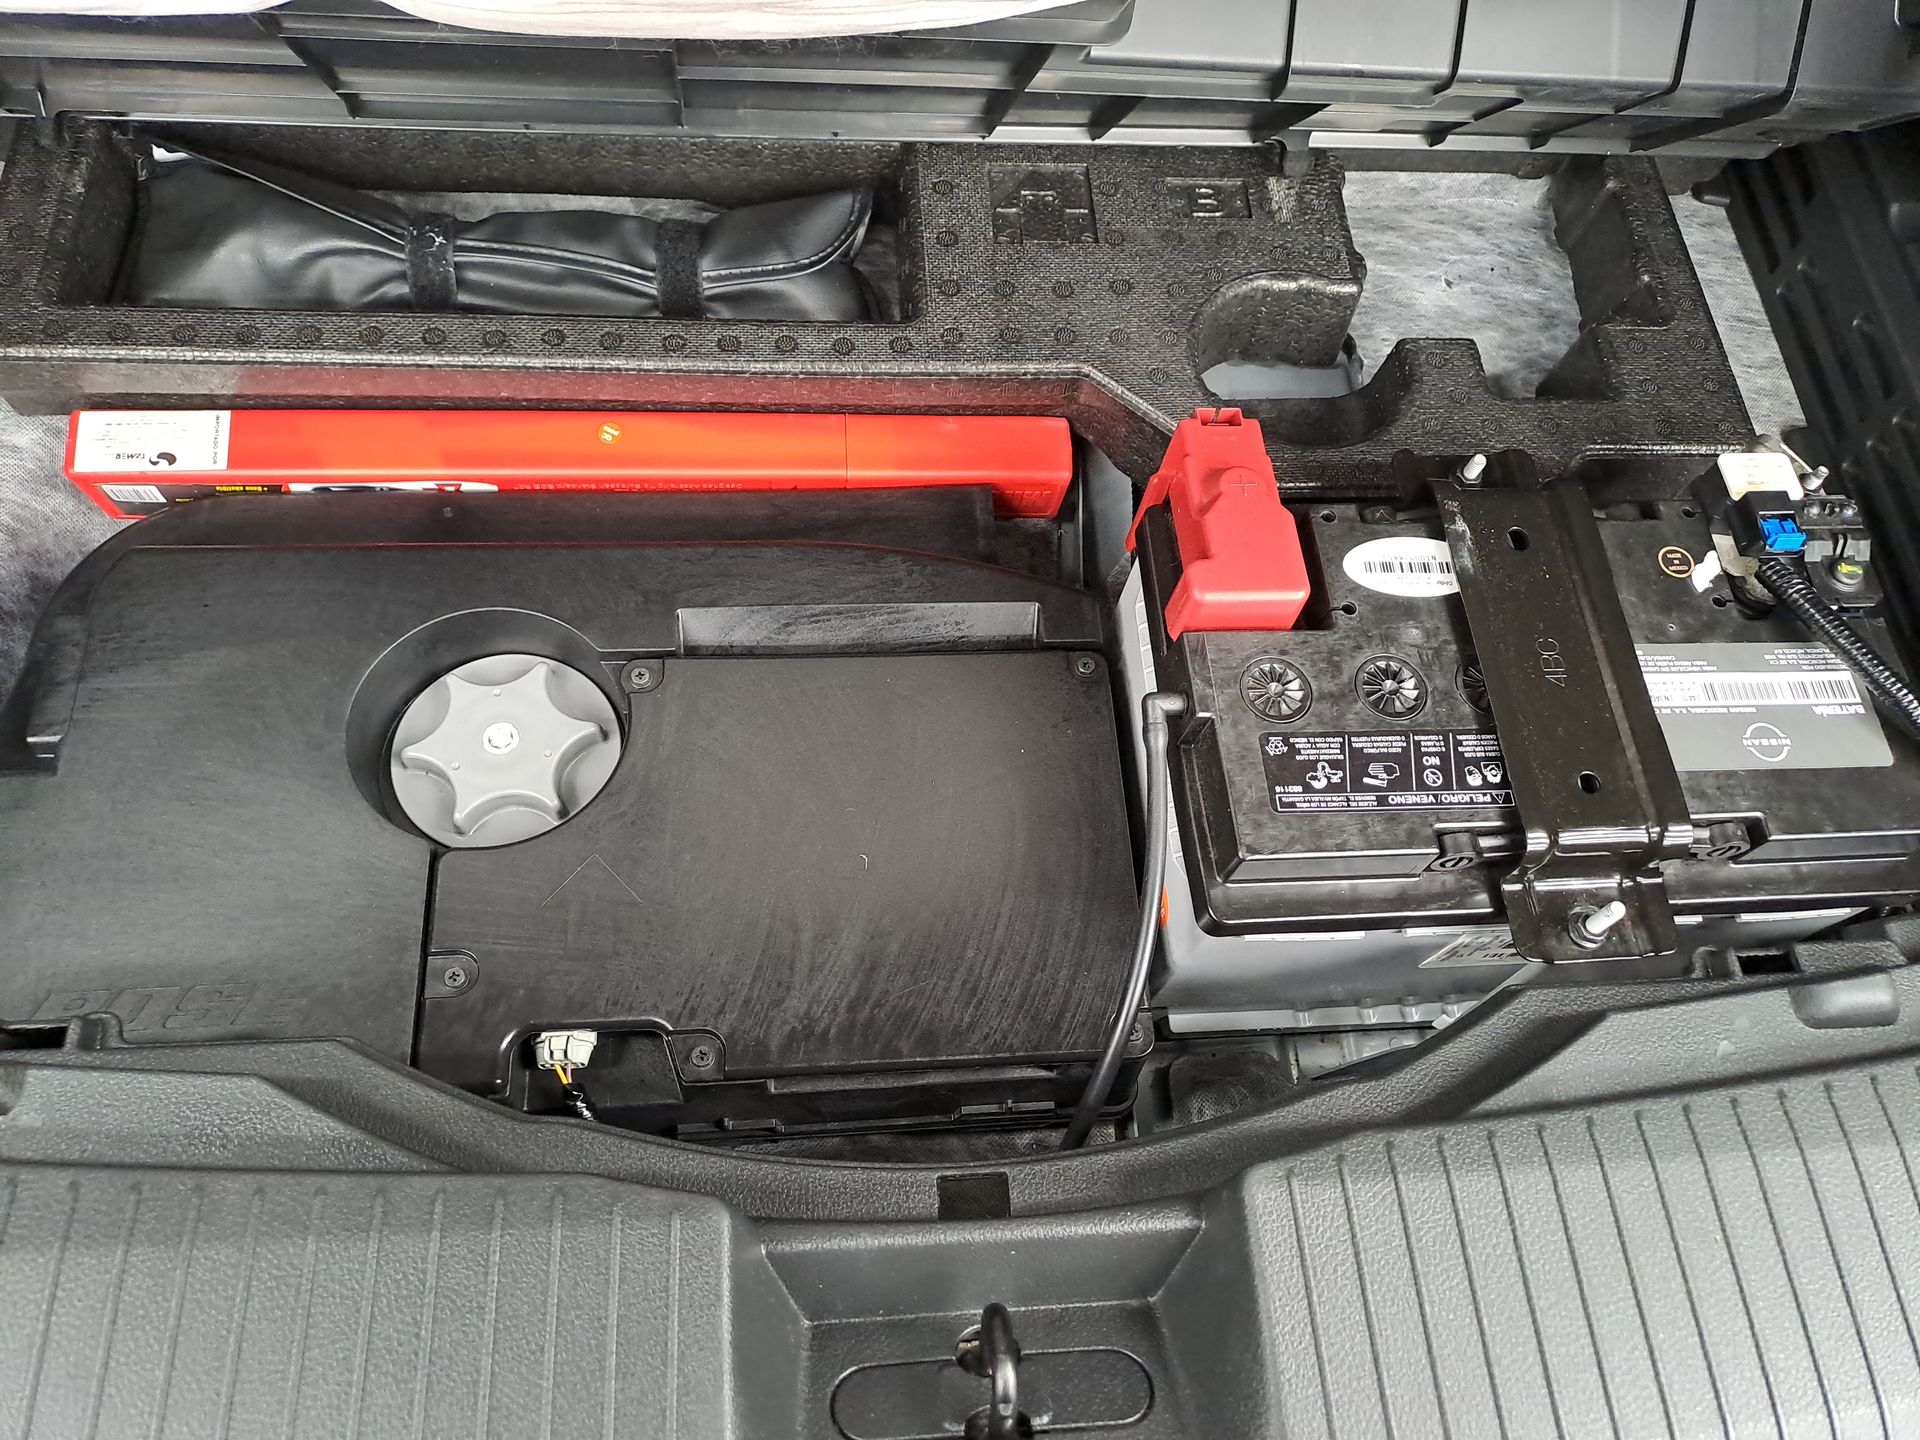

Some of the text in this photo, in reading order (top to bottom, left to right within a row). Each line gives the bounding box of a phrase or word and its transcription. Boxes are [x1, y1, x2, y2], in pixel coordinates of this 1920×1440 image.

[1536, 638, 1568, 687] ABC
[1422, 755, 1440, 765] NO
[1388, 794, 1436, 804] VENENO
